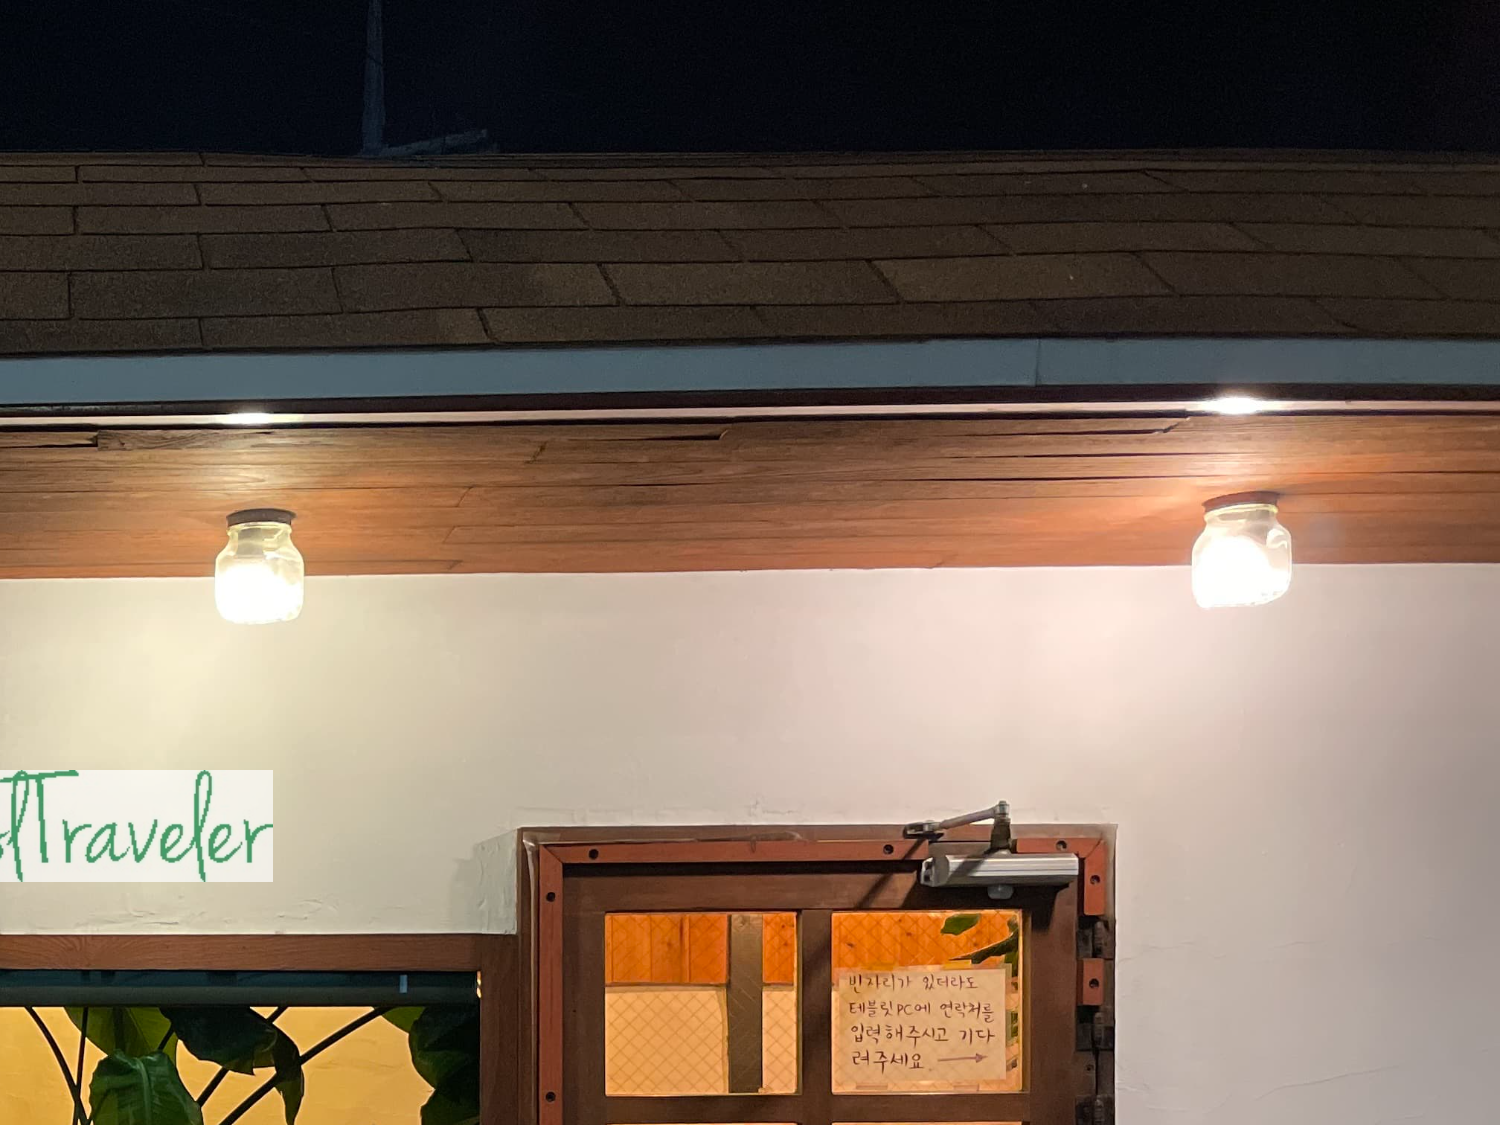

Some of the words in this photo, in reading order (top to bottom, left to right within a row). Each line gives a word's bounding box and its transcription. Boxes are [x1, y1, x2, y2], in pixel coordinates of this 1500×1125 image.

[849, 974, 912, 993] 빈자리가
[922, 974, 978, 990] 있더라도
[939, 1000, 995, 1023] 연락처를
